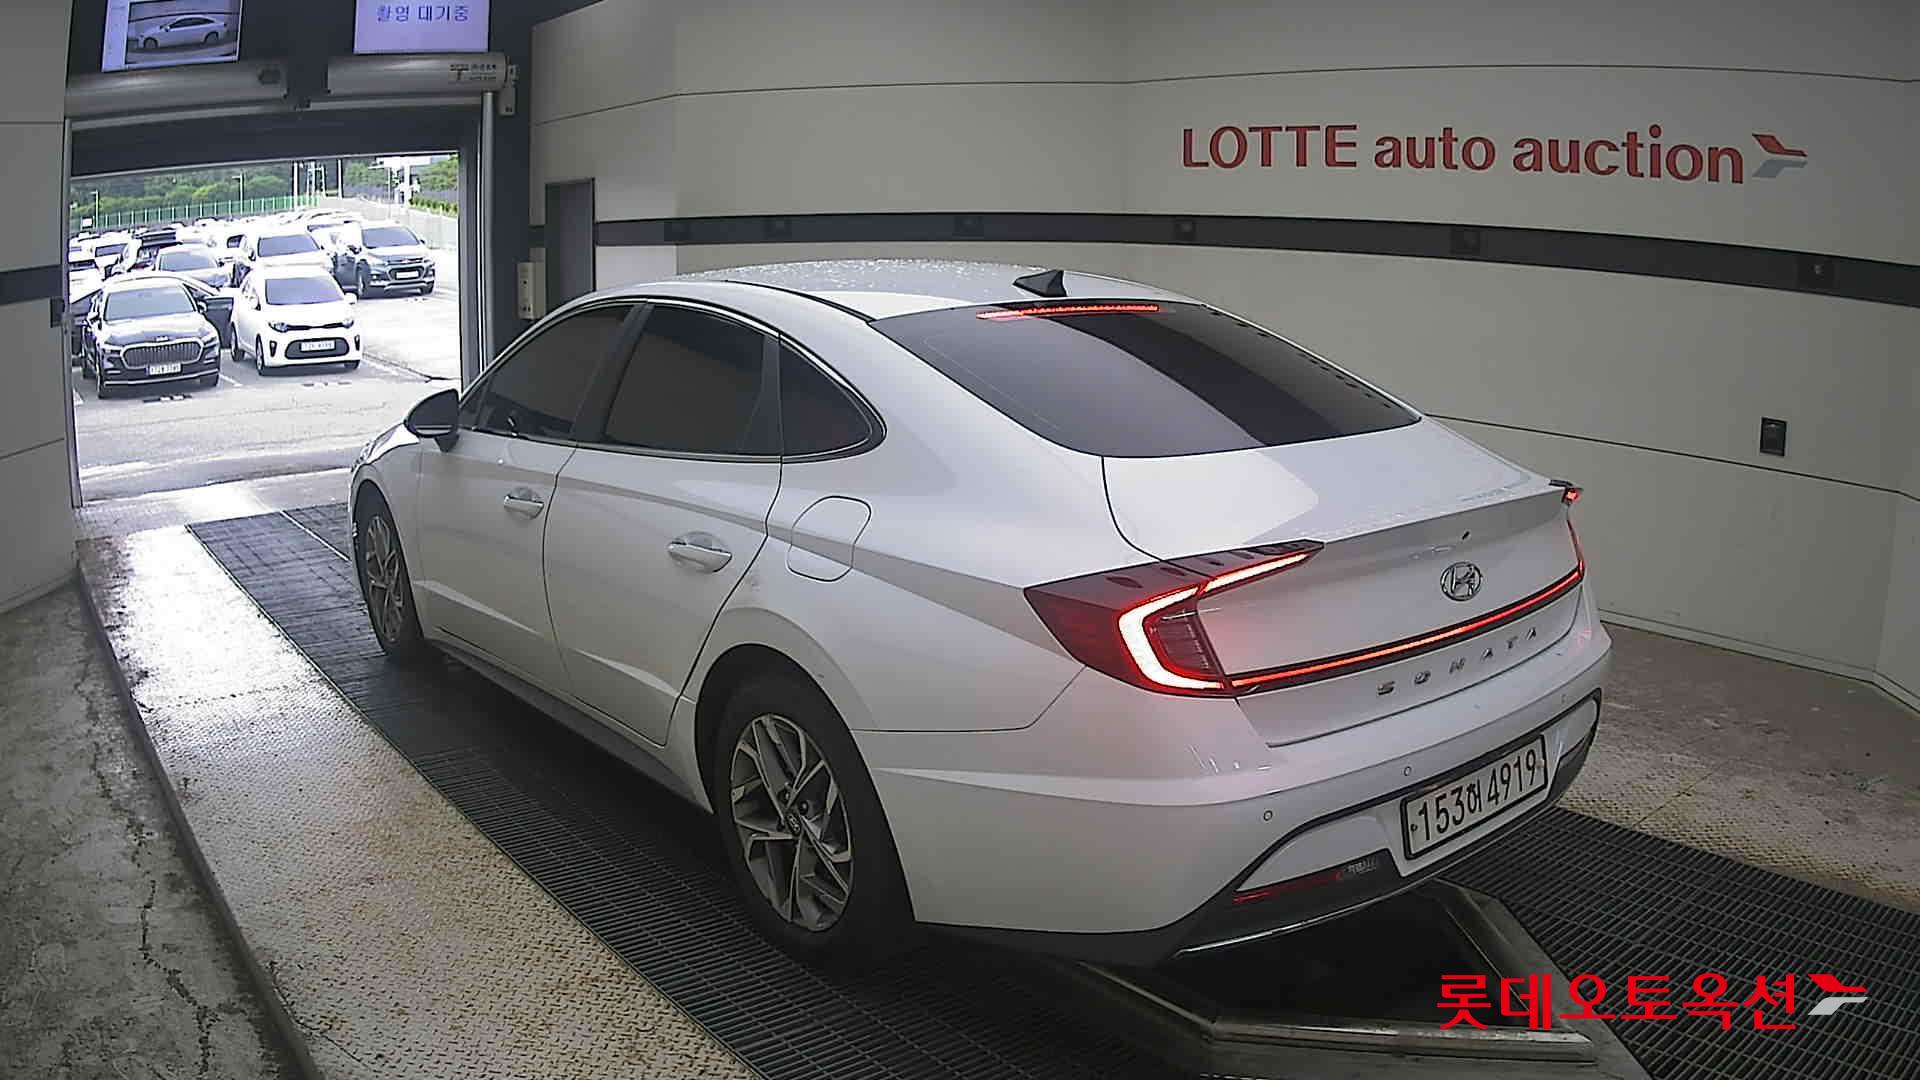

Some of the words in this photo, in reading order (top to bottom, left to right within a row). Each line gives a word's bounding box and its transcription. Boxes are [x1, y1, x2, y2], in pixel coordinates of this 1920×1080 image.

[1182, 124, 1358, 169] LOTTE
[1373, 127, 1496, 170] auto
[1512, 124, 1744, 184] auction
[1376, 627, 1537, 696] SONATA
